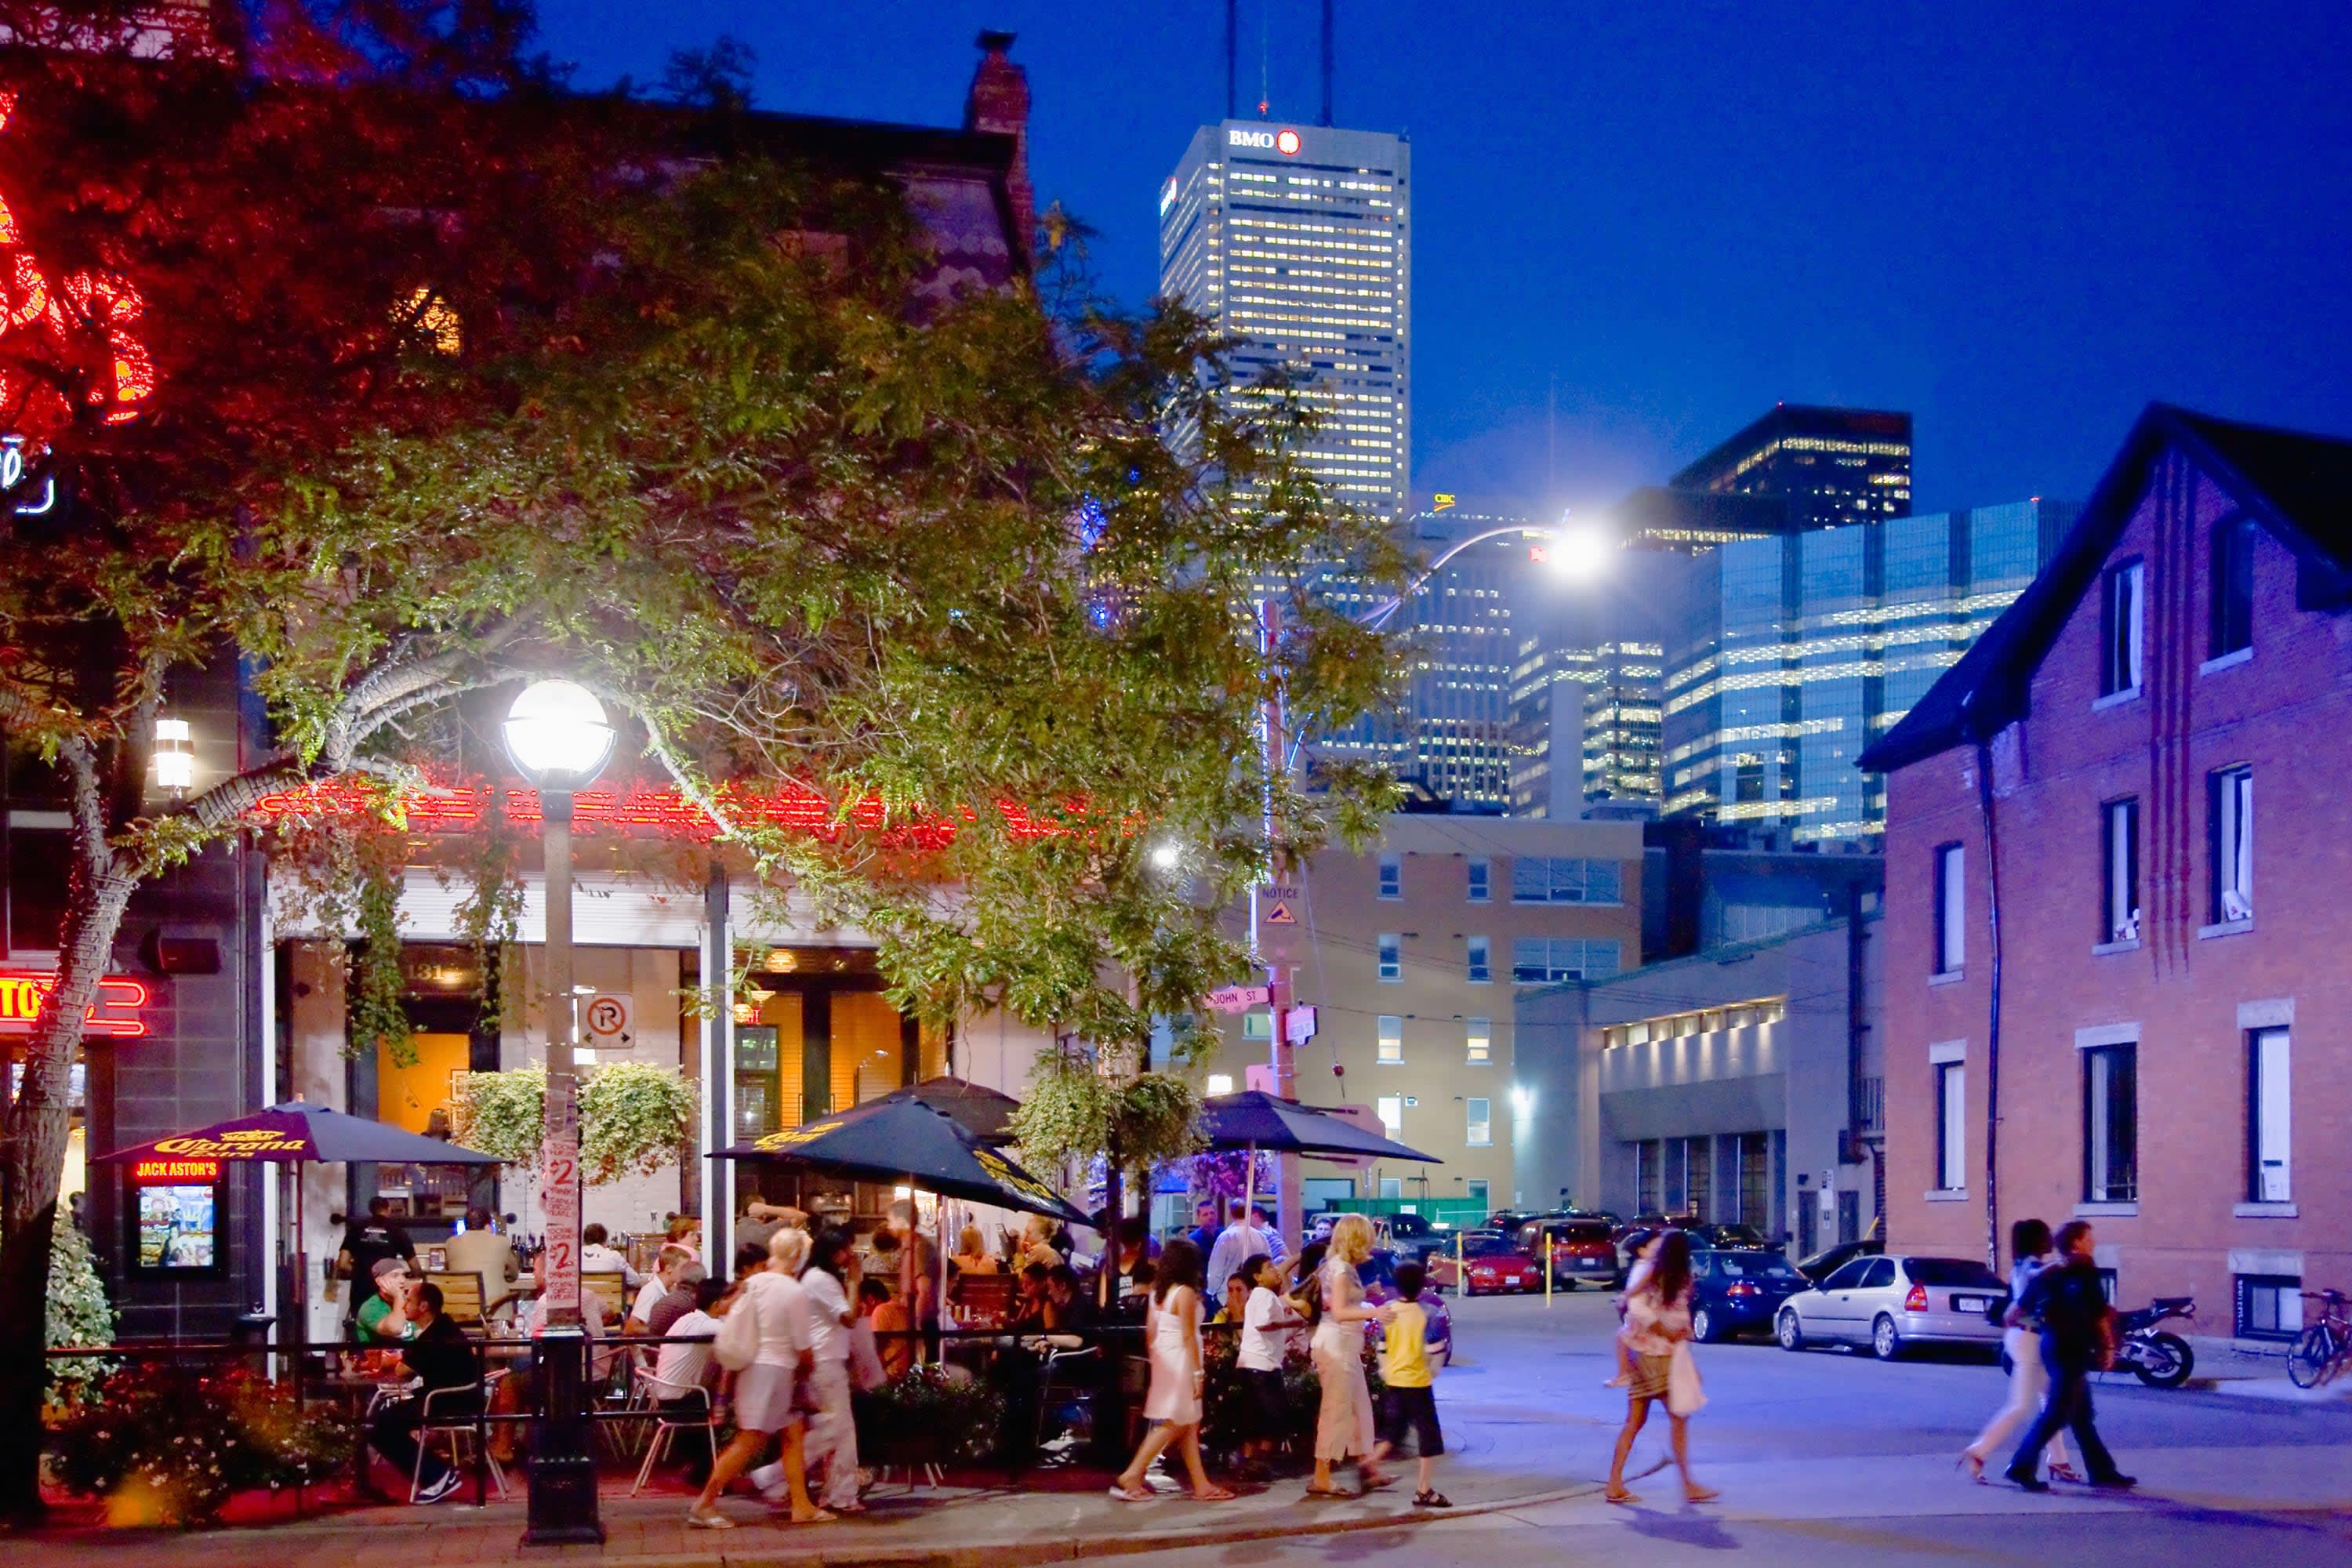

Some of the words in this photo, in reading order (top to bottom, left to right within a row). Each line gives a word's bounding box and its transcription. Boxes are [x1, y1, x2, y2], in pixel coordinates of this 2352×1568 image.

[1229, 130, 1275, 148] BMO
[1262, 887, 1298, 898] NOTICE
[408, 963, 445, 980] 131
[1214, 993, 1238, 1005] JOHN
[154, 1138, 306, 1154] Corona
[136, 1163, 167, 1176] JACK
[169, 1162, 217, 1176] ASTOR'S
